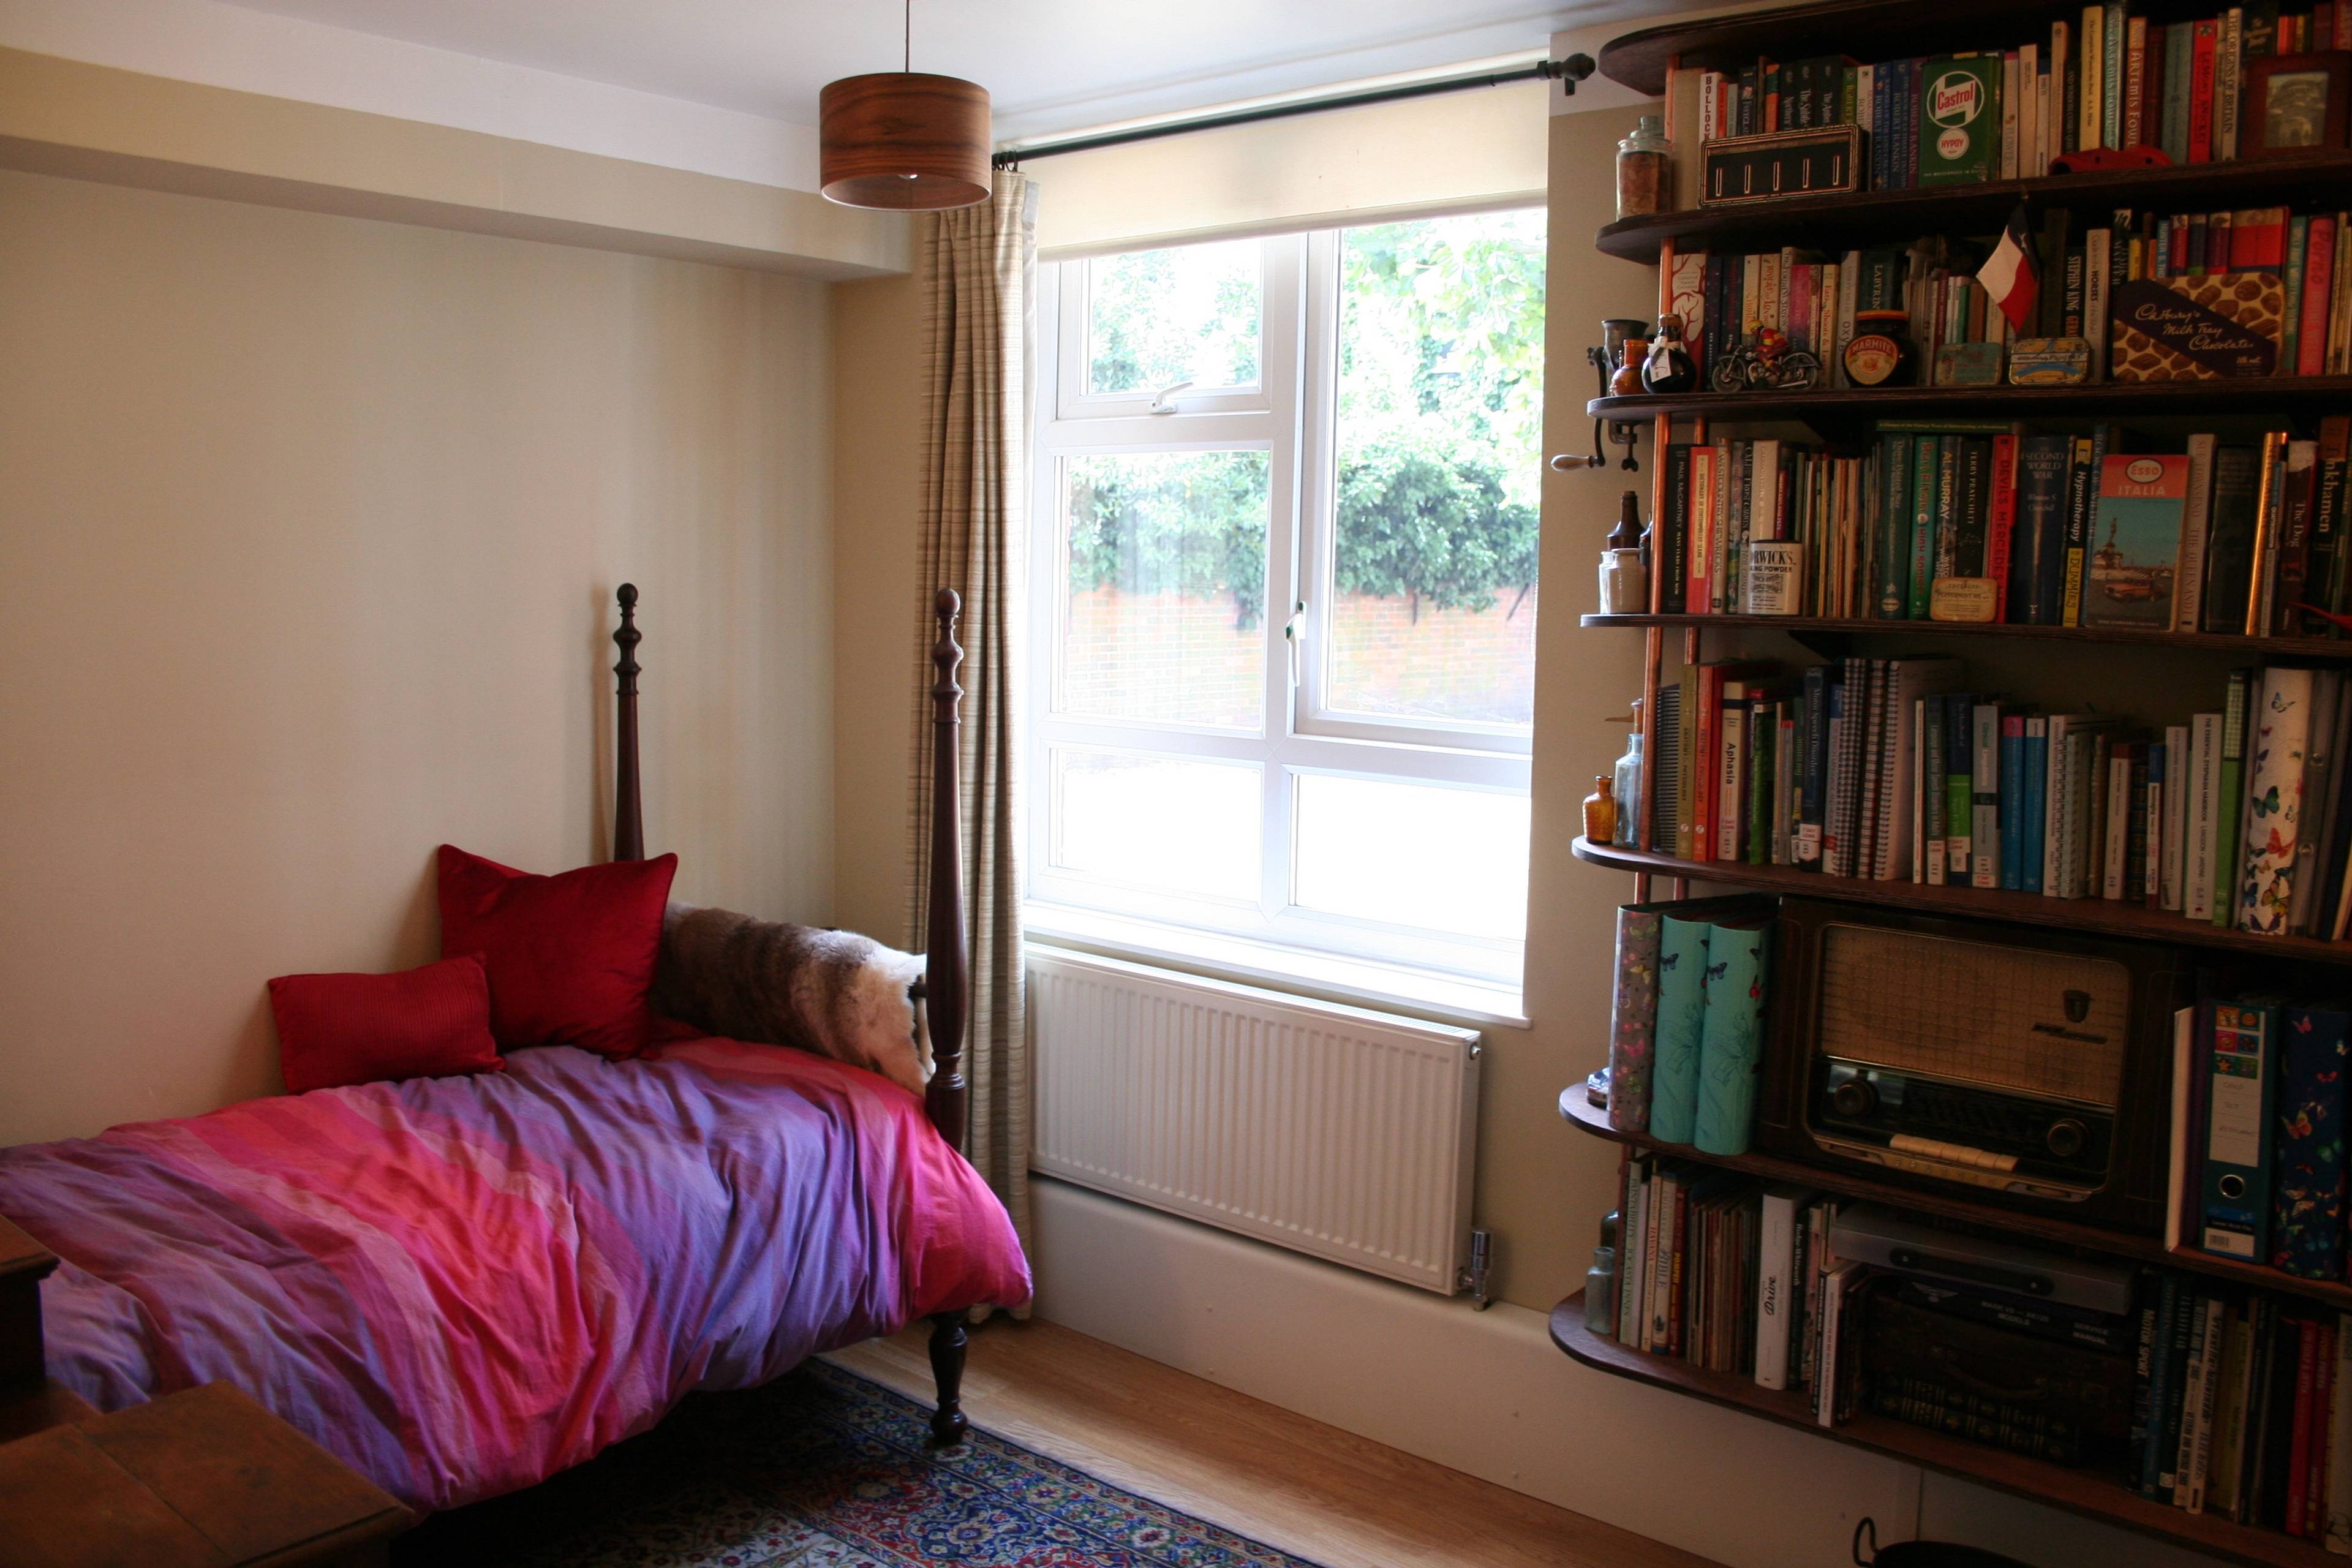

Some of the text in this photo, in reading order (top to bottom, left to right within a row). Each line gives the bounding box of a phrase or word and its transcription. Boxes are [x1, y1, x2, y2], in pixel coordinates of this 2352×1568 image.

[2108, 37, 2118, 88] ARTEMIS
[2226, 37, 2237, 76] ORIGINS
[1937, 83, 1974, 110] Castrol
[2127, 52, 2141, 148] ARTEMIS FOWL
[2225, 79, 2234, 91] OF
[1704, 77, 1713, 140] BOLLOCK
[2107, 92, 2117, 126] FOWL
[2225, 96, 2234, 134] BRITAIN
[1892, 134, 1901, 172] RANKIN
[2006, 127, 2015, 167] FLOWERS
[2158, 223, 2167, 253] HUNTER
[2311, 229, 2332, 284] Porno
[1871, 265, 1883, 311] LABYRIN
[2065, 256, 2081, 311] STEPHEN KING
[2090, 270, 2099, 301] HORSES
[1823, 310, 1831, 335] Shoots
[2135, 303, 2201, 323] Cadbury's
[2162, 323, 2223, 336] Milk Tray
[1852, 339, 1891, 353] MARMITE
[2025, 452, 2064, 461] SECOND
[2027, 461, 2062, 470] WORLD
[2130, 464, 2158, 476] Esso
[1675, 483, 1684, 528] McCARTNEY
[1940, 451, 1953, 519] AL MURRAY
[1967, 451, 1978, 524] TERRY PRATCHETT
[2117, 484, 2166, 496] ITALIA
[2318, 461, 2340, 533] nkhamen
[1714, 454, 1726, 573] WESTCOUNTRY SHIPWRECKS
[1916, 442, 1934, 595] Ben Elton HIGH SOCIETY
[1993, 460, 2010, 580] DEVIL'S MERCEDES
[2184, 441, 2207, 608] SUE TOWNSEND THE QUEEN AND
[2290, 502, 2306, 548] The Dog
[2067, 471, 2087, 608] Hypnotherapy DUMMIES
[1809, 687, 1822, 776] Motor Speech Disorders
[1725, 742, 1737, 785] Aphasia
[1623, 1178, 1638, 1317] PAINTABILITY JOCASTA INNES
[1648, 1226, 1657, 1262] HAVANA
[1793, 1223, 1803, 1286] Rudge-Whitworth
[1657, 1248, 1672, 1289] BIBLE
[1763, 1276, 1777, 1316] Drive
[2138, 1308, 2155, 1378] MOTOR SPORT
